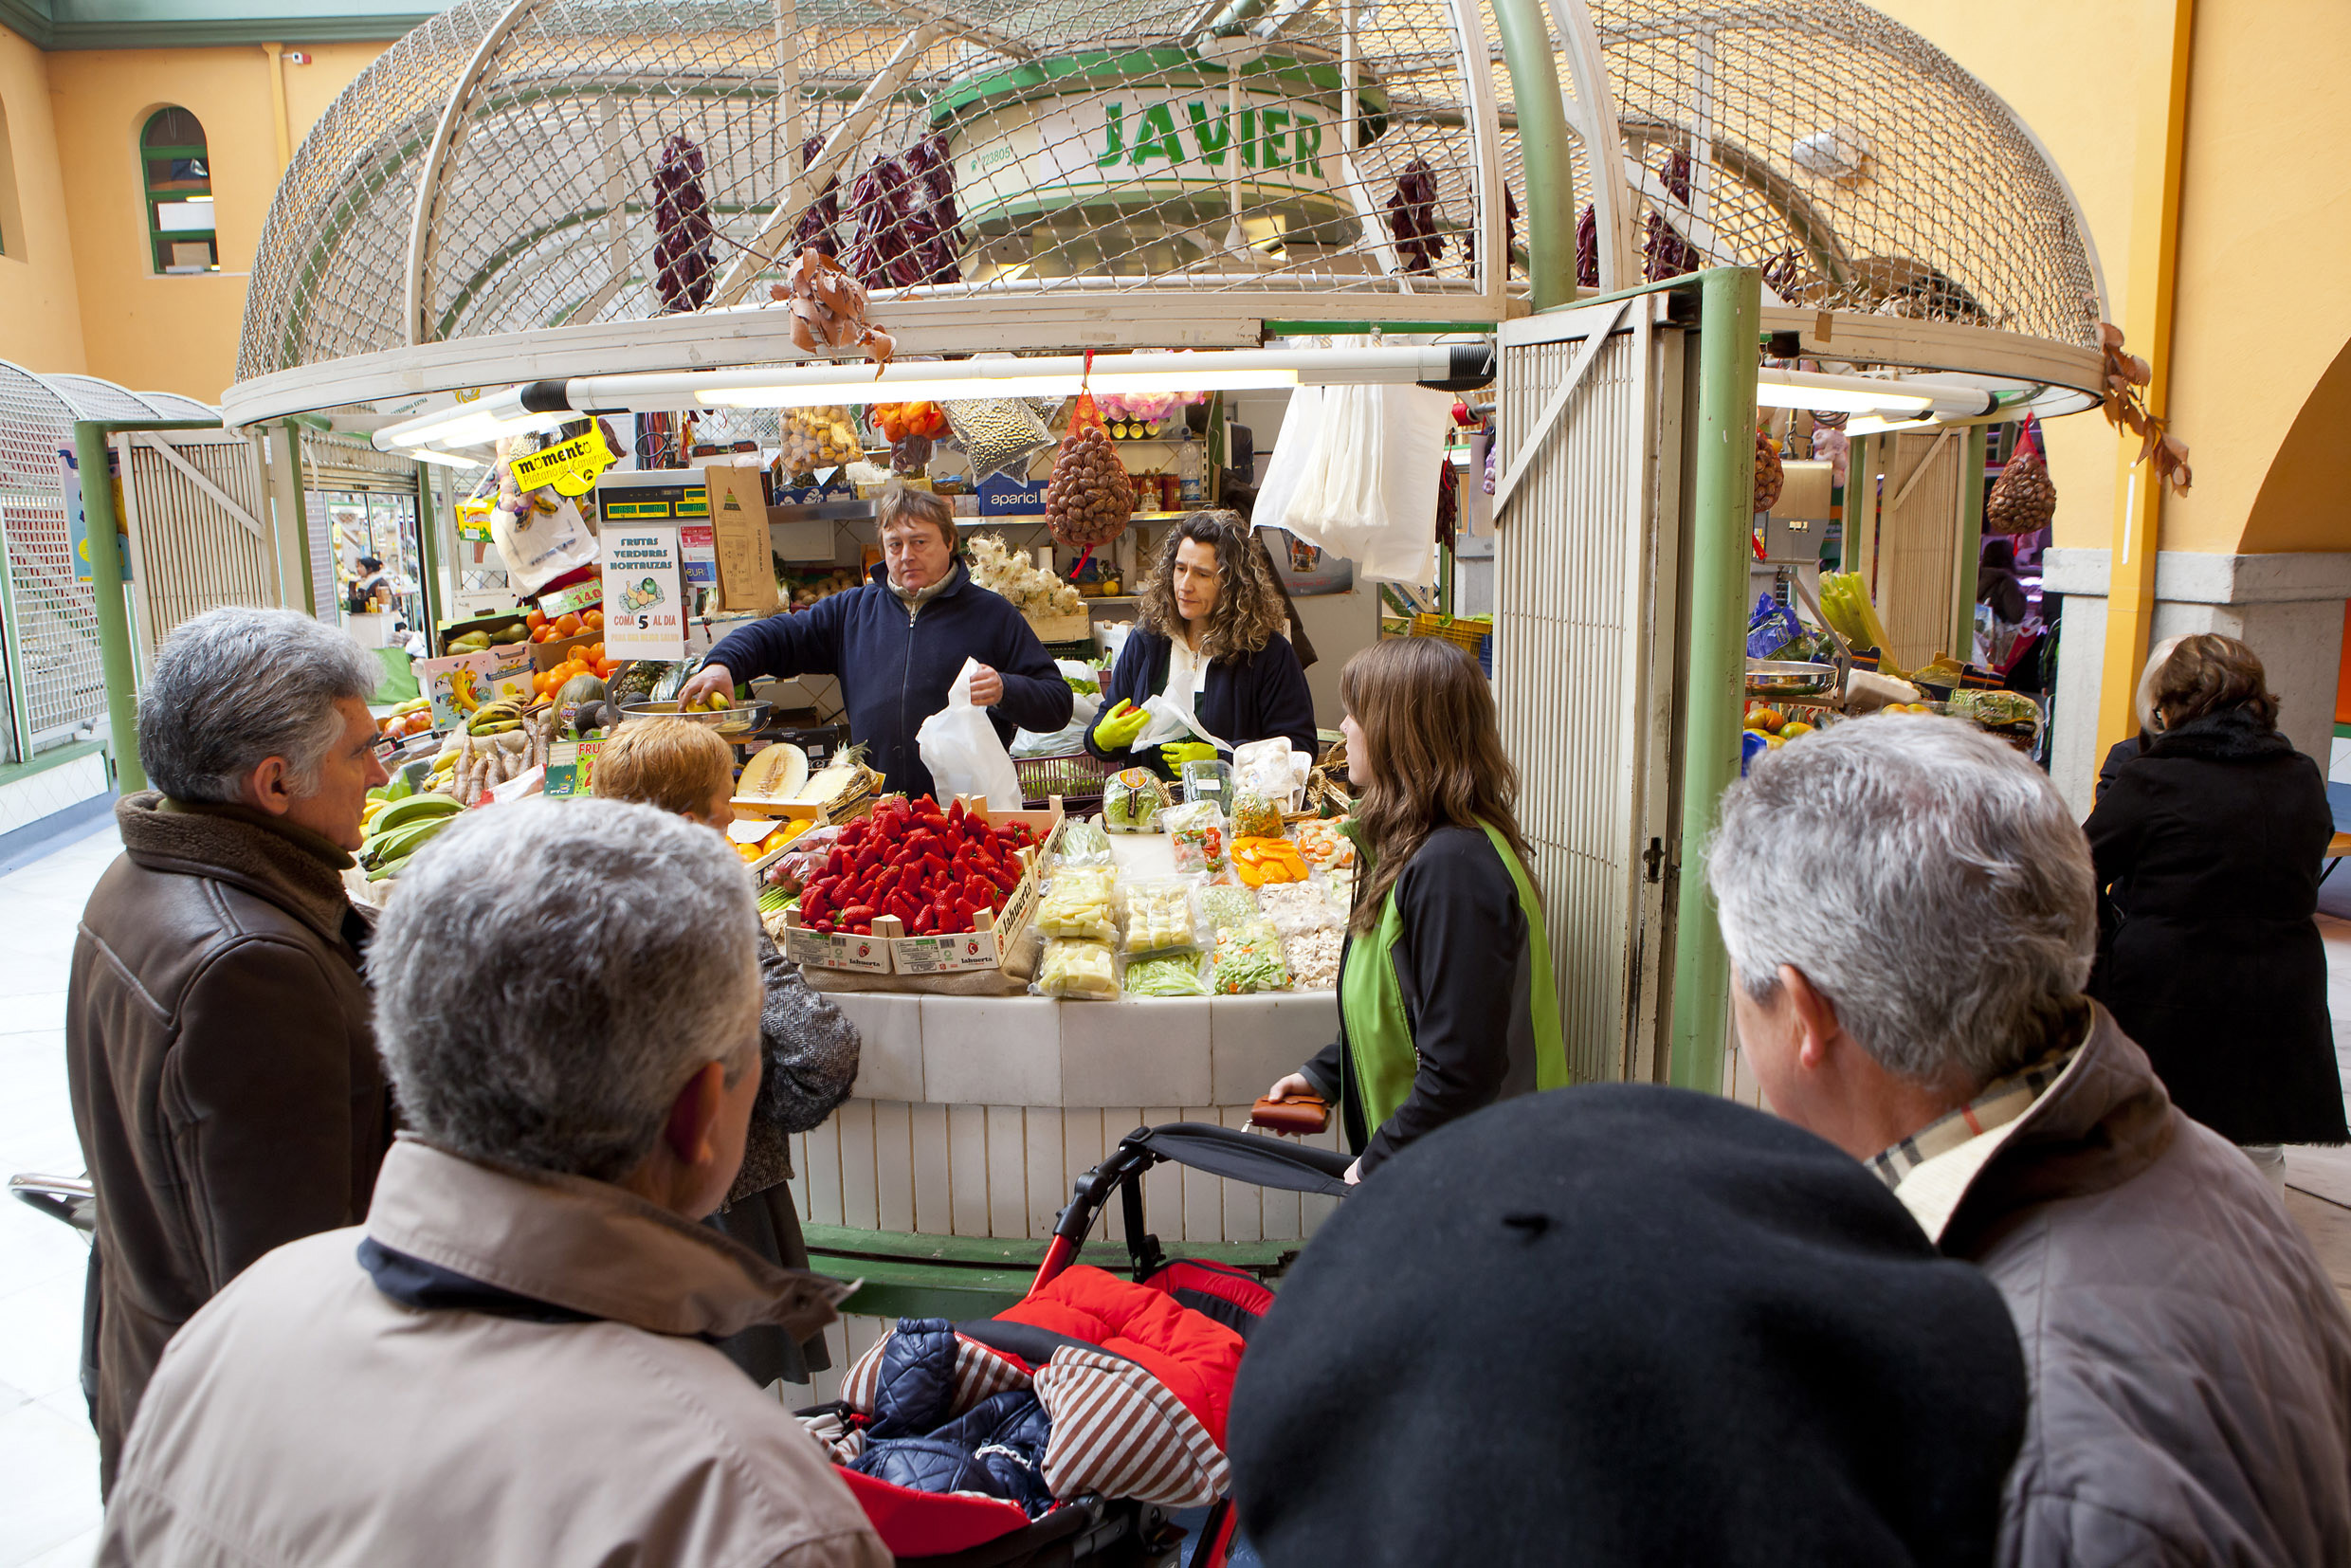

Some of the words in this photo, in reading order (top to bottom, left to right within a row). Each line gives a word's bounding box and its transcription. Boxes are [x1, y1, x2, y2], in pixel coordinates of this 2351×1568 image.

[1097, 100, 1322, 179] JAVIER
[981, 146, 1011, 166] 223805
[522, 466, 559, 485] Plátano
[571, 451, 611, 471] Canarias
[991, 491, 1038, 507] aparici
[620, 538, 659, 546] FRUTAS
[613, 549, 668, 558] VERDURAS
[610, 561, 673, 570] HORTALIZAS
[563, 580, 598, 597] FRUTAS
[613, 614, 635, 627] COMA
[638, 614, 649, 629] 5
[652, 615, 663, 626] AL
[664, 614, 677, 626] DIA
[577, 741, 606, 757] FRU
[1002, 881, 1032, 937] lahuerta
[849, 957, 881, 968] lahuerta
[960, 956, 993, 965] lahuerta
